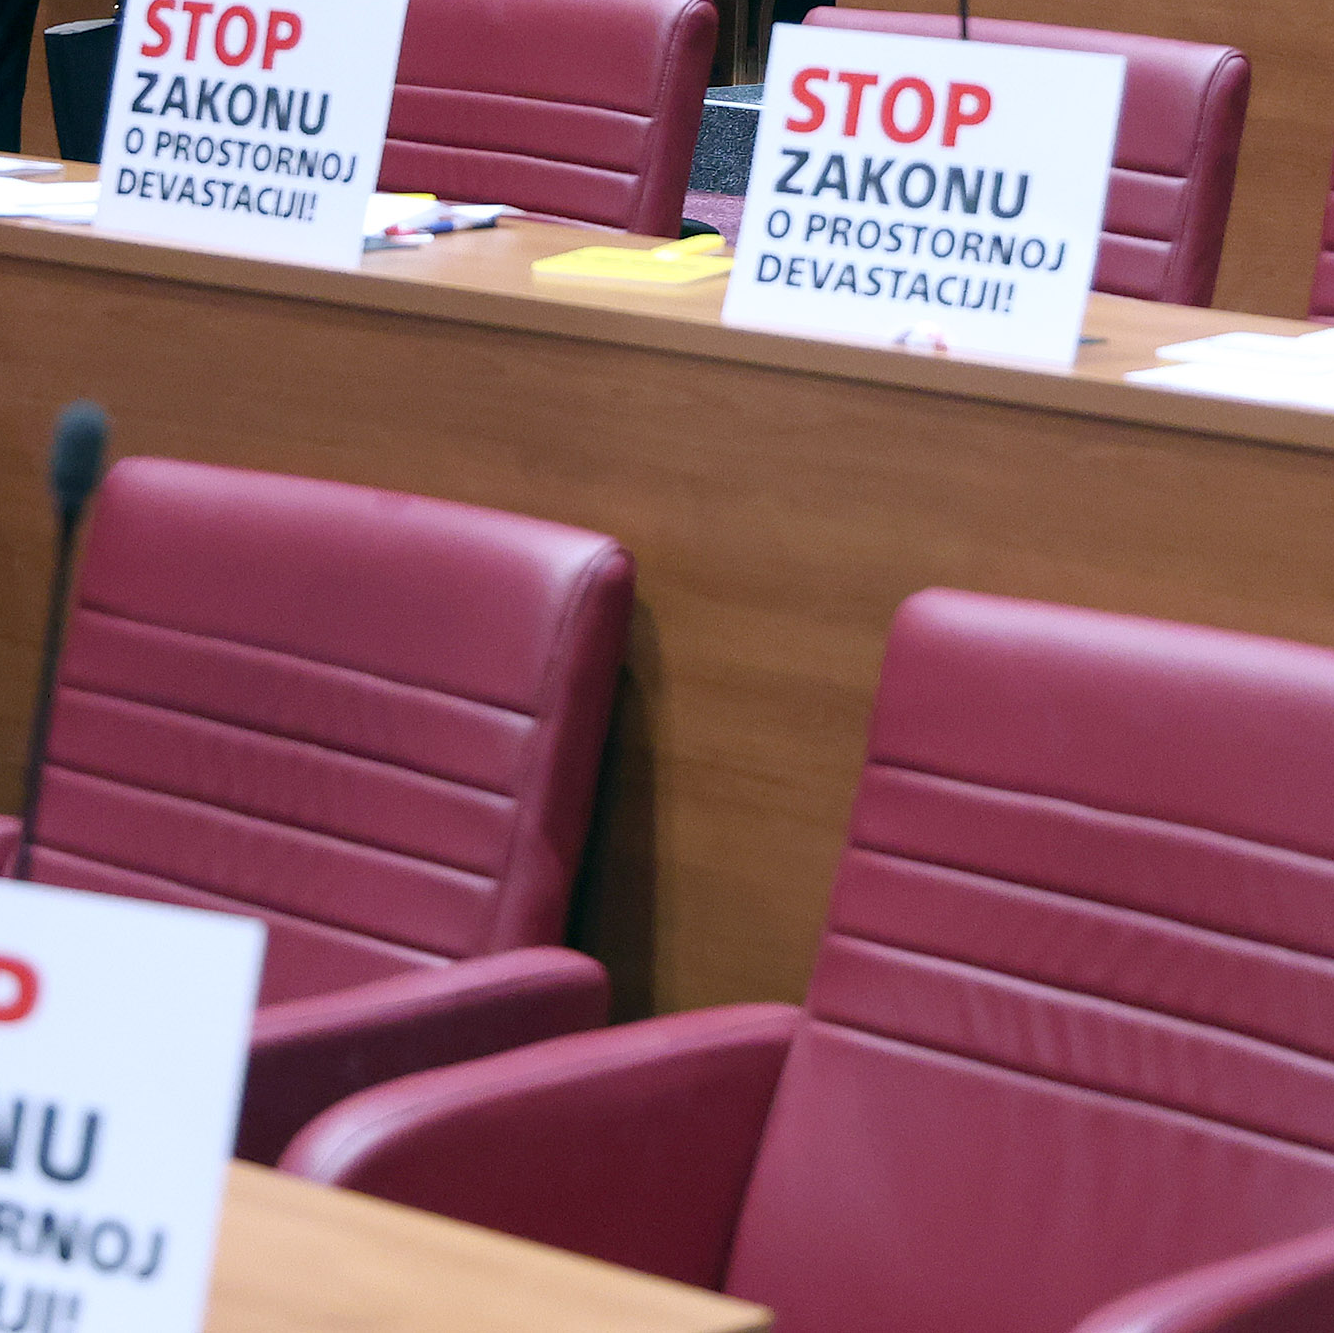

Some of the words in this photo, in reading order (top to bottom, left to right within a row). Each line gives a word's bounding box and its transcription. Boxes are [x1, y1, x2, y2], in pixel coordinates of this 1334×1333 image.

[131, 71, 329, 136] ZAKONU
[785, 68, 993, 148] STOP
[125, 128, 144, 154] O
[155, 130, 357, 183] PROSTORNOJ
[775, 148, 1029, 219] ZAKONU
[116, 168, 317, 221] DEVASTACIJI!
[767, 209, 791, 238] O
[805, 213, 1067, 271] PROSTORNOJ
[757, 254, 1014, 314] DEVASTACIJI!
